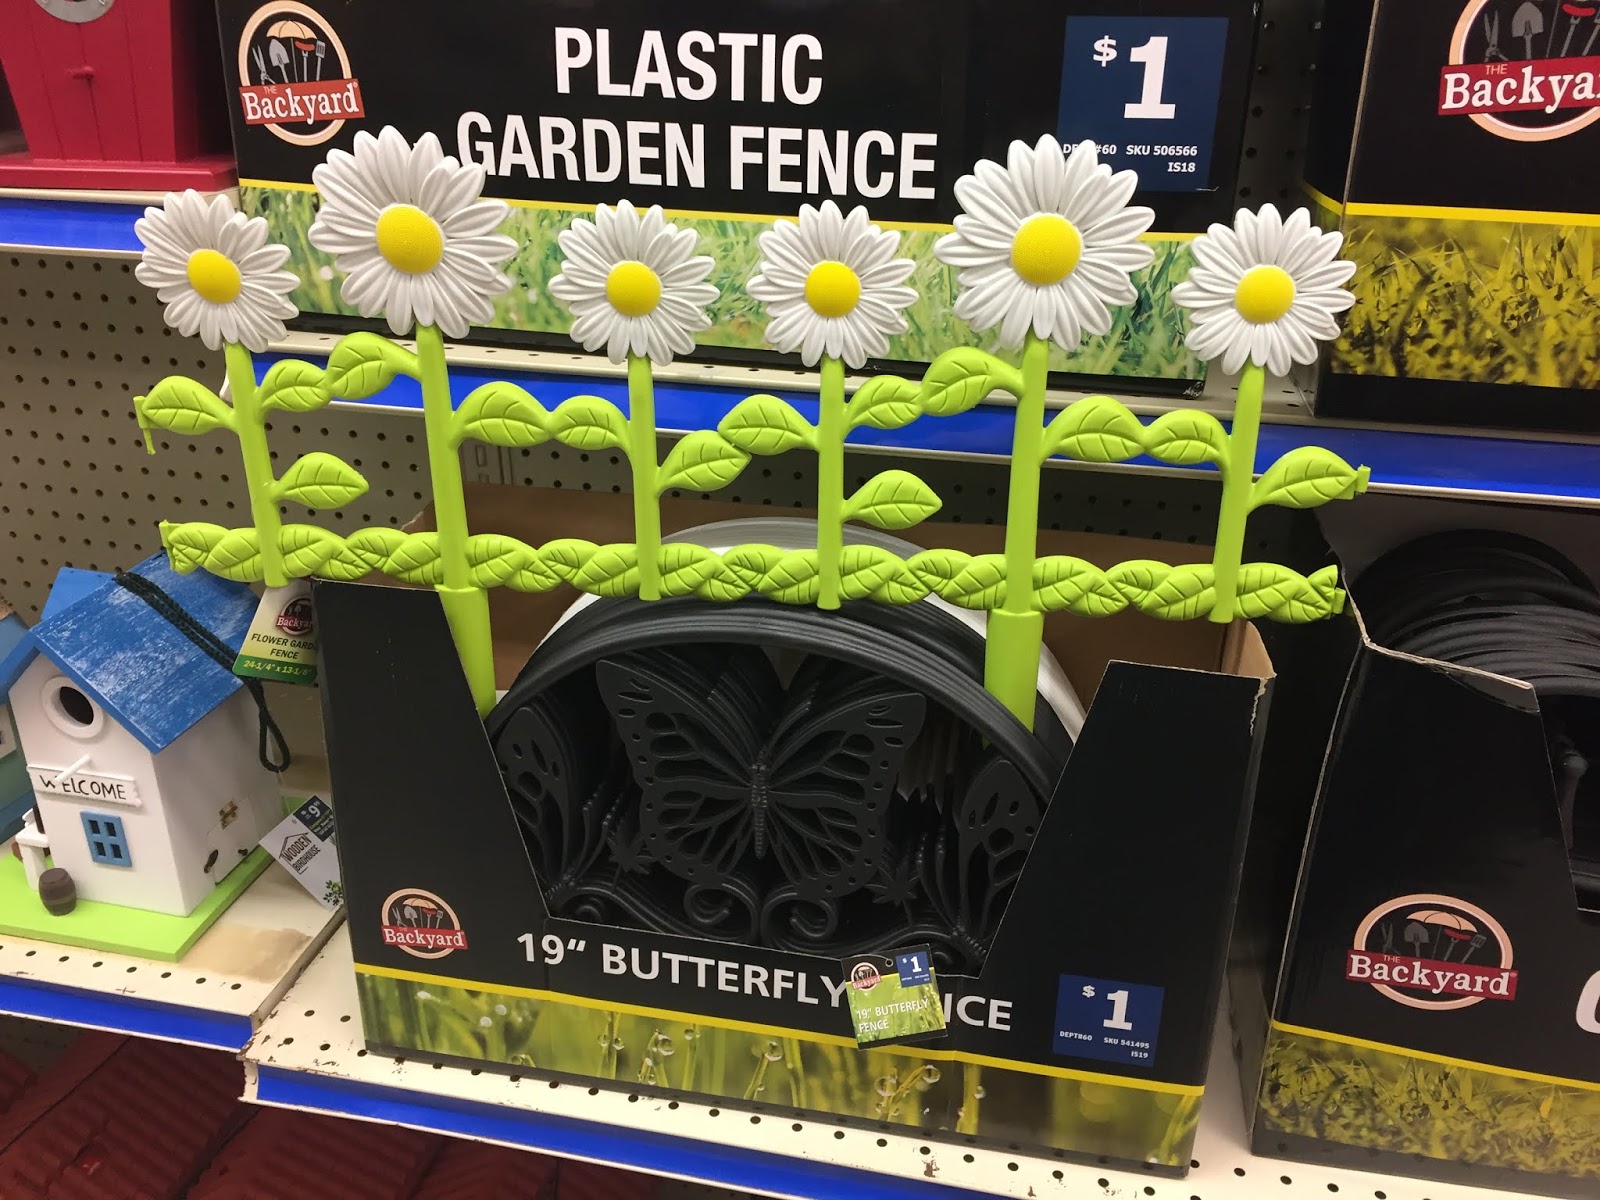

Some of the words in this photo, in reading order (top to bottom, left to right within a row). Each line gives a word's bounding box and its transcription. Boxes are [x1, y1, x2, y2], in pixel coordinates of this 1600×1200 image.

[555, 27, 823, 105] PLASTIC
[1485, 64, 1508, 75] THE
[263, 86, 278, 95] THE
[1441, 64, 1600, 114] Backya
[241, 81, 360, 125] Backyard
[457, 111, 705, 188] GARDEN
[730, 124, 938, 199] FENCE
[1125, 144, 1151, 156] SKU
[1153, 145, 1198, 156] 506566
[1167, 162, 1196, 173] IS18
[251, 633, 289, 647] FLOWER
[270, 648, 299, 660] FENCE
[281, 834, 312, 862] WOODEN
[292, 844, 321, 871] BIRDHOUSE
[383, 928, 464, 949] Backyard
[1383, 954, 1401, 963] THE
[602, 943, 846, 1008] BUTTERFLY
[1349, 954, 1509, 994] Backyard
[875, 997, 929, 1017] BUTTERFLY
[859, 1018, 889, 1034] FENCE
[1059, 1030, 1093, 1042] DEPT#60
[1103, 1037, 1119, 1045] SKU
[1120, 1039, 1150, 1050] 541495
